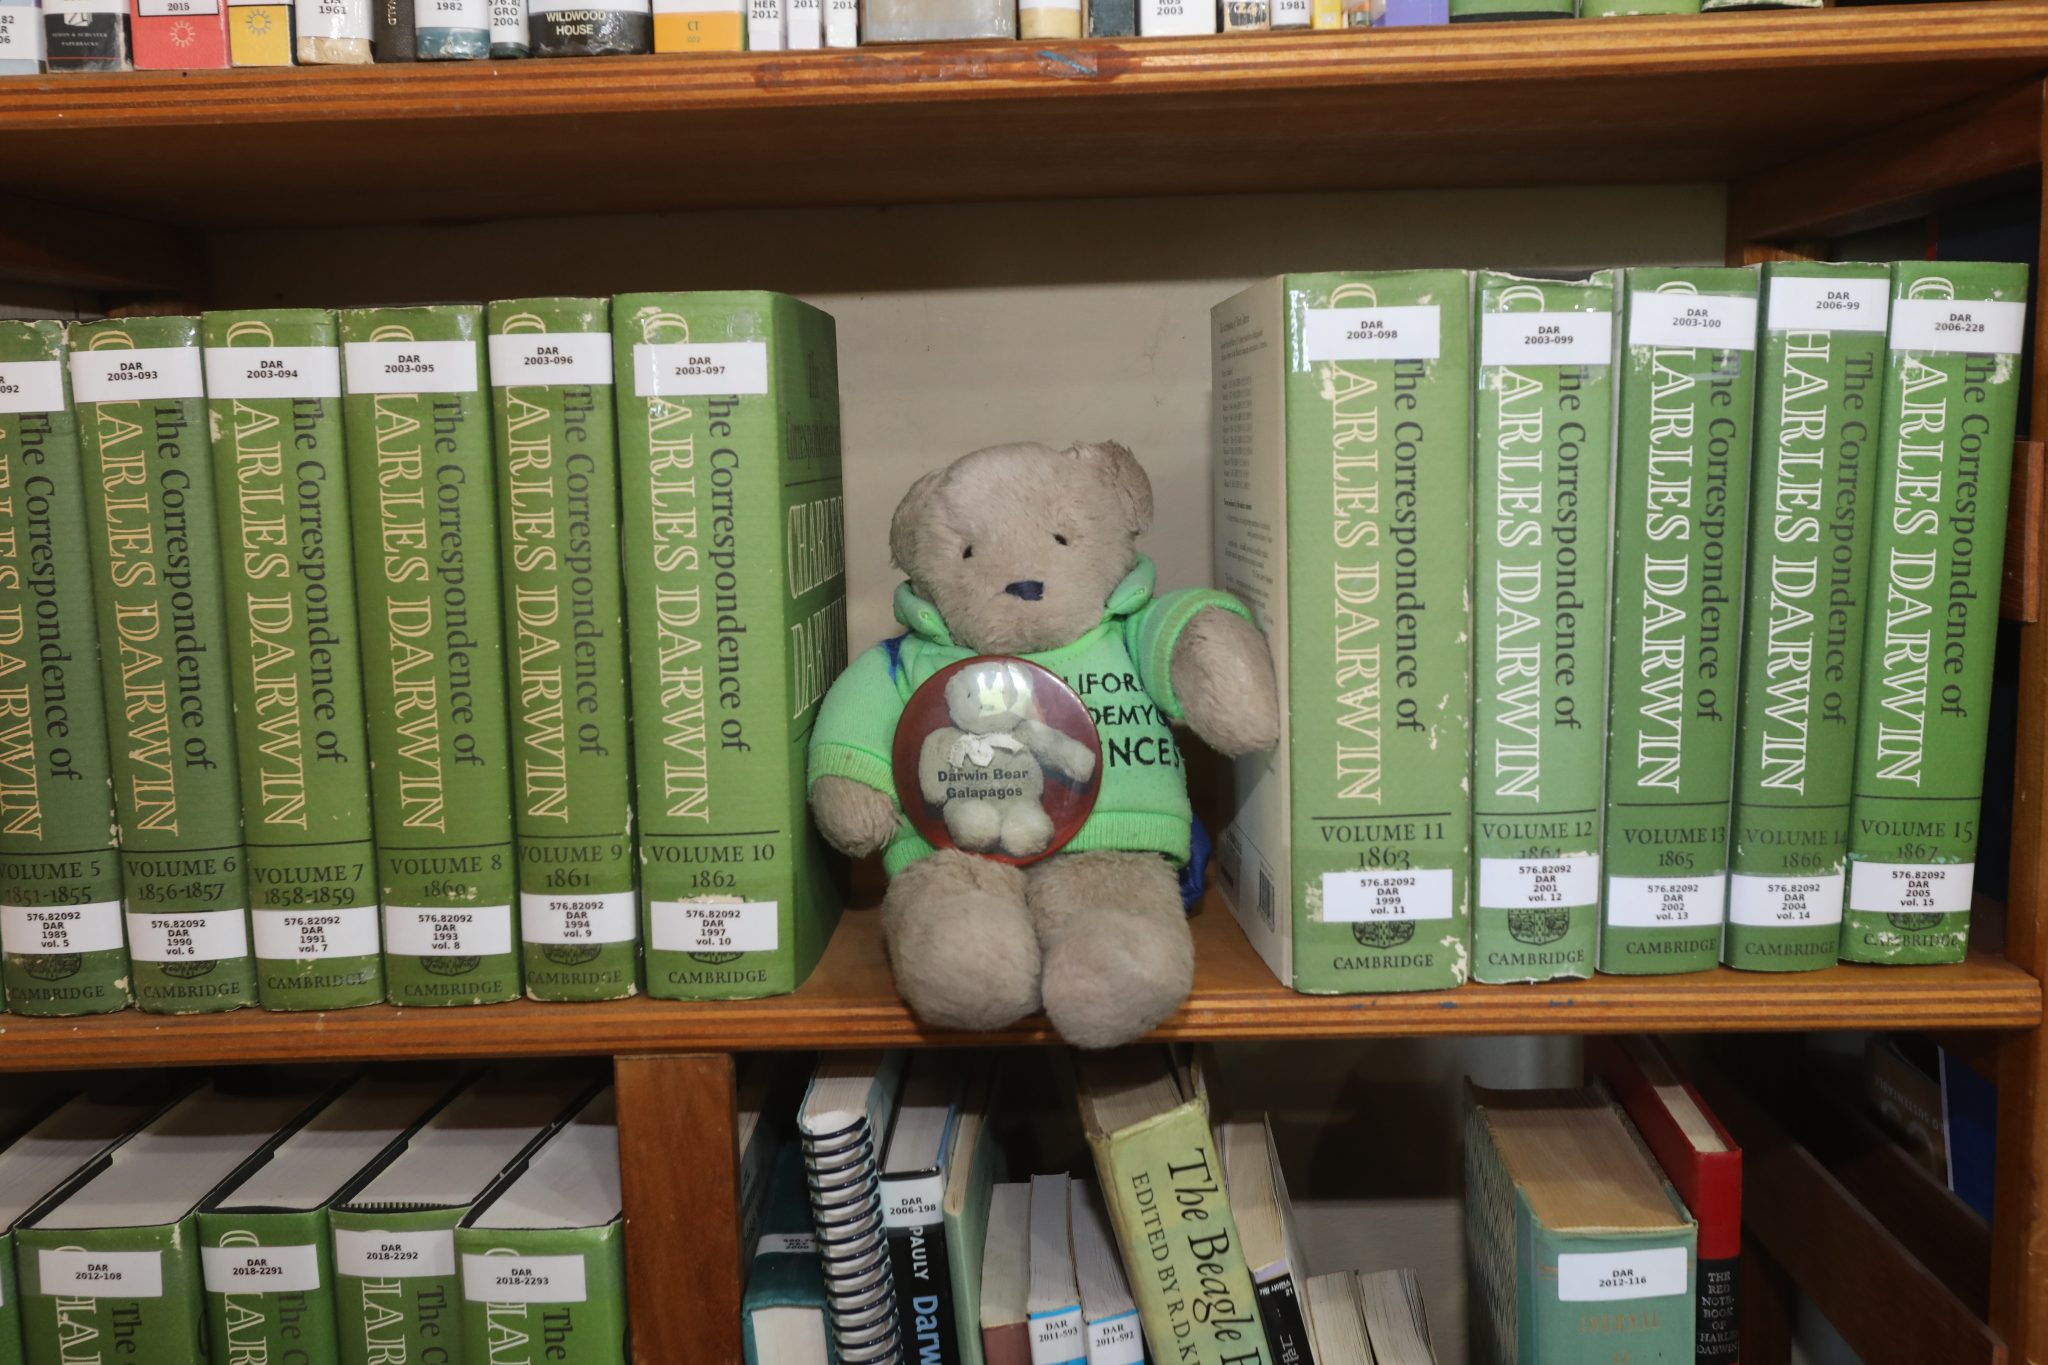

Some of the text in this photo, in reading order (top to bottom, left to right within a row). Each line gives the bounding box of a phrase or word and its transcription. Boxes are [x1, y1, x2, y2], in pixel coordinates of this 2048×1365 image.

[168, 3, 190, 12] 2015
[436, 2, 463, 11] 1982
[754, 0, 776, 8] HER
[1280, 1, 1306, 10] 1981
[319, 6, 347, 14] 1961
[494, 7, 518, 16] GRO
[752, 10, 779, 19] 2012
[1156, 7, 1184, 15] 2003
[546, 11, 606, 22] WILDWOOD
[493, 18, 519, 26] 2004
[556, 24, 593, 36] HOUSE
[1827, 292, 1850, 300] DAR
[1816, 301, 1860, 310] 2006-99
[1687, 309, 1708, 317] DAR
[1361, 321, 1383, 329] DAR
[1672, 318, 1721, 327] 2003-100
[1935, 322, 1985, 332] 2006-228
[1538, 326, 1560, 334] DAR
[1346, 331, 1398, 339] 2003-098
[1524, 336, 1574, 344] 2003-099
[537, 347, 558, 355] DAR
[398, 355, 420, 363] DAR
[524, 356, 573, 365] 2003-096
[689, 357, 711, 365] DAR
[120, 362, 142, 370] DAR
[385, 365, 434, 373] 2003-095
[247, 370, 298, 378] 2003-094
[675, 367, 725, 375] 2003-097
[108, 371, 158, 381] 2003-093
[1822, 351, 1874, 725] The Correspondence of
[1390, 421, 1425, 688] Correspondence
[642, 312, 709, 823] CARLES DARWIN
[1760, 330, 1830, 796] HARLES DARWIN
[436, 464, 477, 723] Correspondence
[160, 469, 206, 728] Correspondence
[184, 738, 216, 770] of
[22, 475, 72, 738] Correspondence
[48, 747, 82, 781] of
[1396, 698, 1425, 732] of
[454, 733, 485, 766] of
[937, 768, 1029, 782] Darwin Bear
[946, 786, 1023, 801] Galapagos
[1320, 823, 1444, 842] VOLUME 11
[1860, 819, 1973, 842] VOLUME 15
[652, 844, 774, 864] VOLUME 10
[128, 856, 236, 878] VOLUME 6
[390, 854, 502, 875] VOLUME 8
[1519, 866, 1572, 874] 576.82092
[1535, 875, 1556, 883] DAR
[1892, 871, 1946, 879] 576.82092
[1360, 878, 1416, 887] 576.82092
[1377, 888, 1399, 896] DAR
[1533, 884, 1558, 892] 2001
[1768, 884, 1820, 892] 576.82092
[1376, 897, 1401, 905] 1999
[1663, 894, 1683, 902] DAR
[550, 902, 604, 910] 576.82092
[1370, 906, 1390, 914] vol.
[27, 912, 80, 921] 576.82092
[418, 914, 472, 922] 576.82092
[686, 910, 741, 918] 576.82092
[151, 920, 206, 928] 576.82092
[284, 916, 340, 925] 576.82092
[565, 920, 590, 928] 1994
[43, 922, 64, 930] DAR
[302, 926, 323, 934] DAR
[435, 924, 456, 932] DAR
[41, 940, 60, 948] vol.
[167, 938, 192, 946] 1990
[1626, 938, 1716, 954] CAMBRIDGE
[299, 944, 318, 952] vol.
[1333, 954, 1433, 970] CAMBRIDGE
[668, 970, 767, 983] CAMBRIDGE
[144, 982, 240, 998] CAMBRIDGE
[404, 981, 502, 997] CAMBRIDGE
[1168, 1147, 1218, 1221] The
[901, 1196, 923, 1206] DAR
[890, 1203, 937, 1216] 2006-198
[1132, 1171, 1170, 1257] EDITED
[1158, 1267, 1180, 1291] BY
[381, 1244, 401, 1252] DAR
[366, 1252, 418, 1260] 2018-2292
[908, 1226, 930, 1282] PAULY
[233, 1267, 283, 1275] 2018-2291
[1612, 1269, 1634, 1278] DAR
[75, 1272, 122, 1280] 2012-108
[1708, 1272, 1731, 1282] THE
[496, 1277, 549, 1285] 2018-2293
[1188, 1228, 1254, 1341] Beagle
[1599, 1277, 1648, 1288] 2012-116
[1708, 1284, 1730, 1294] RED
[417, 1284, 448, 1337] The
[112, 1302, 142, 1354] The
[1046, 1320, 1068, 1330] DAR
[1103, 1324, 1124, 1334] DAR
[543, 1307, 573, 1360] The
[1039, 1328, 1078, 1342] 2011-593
[1096, 1332, 1134, 1347] 2011-592
